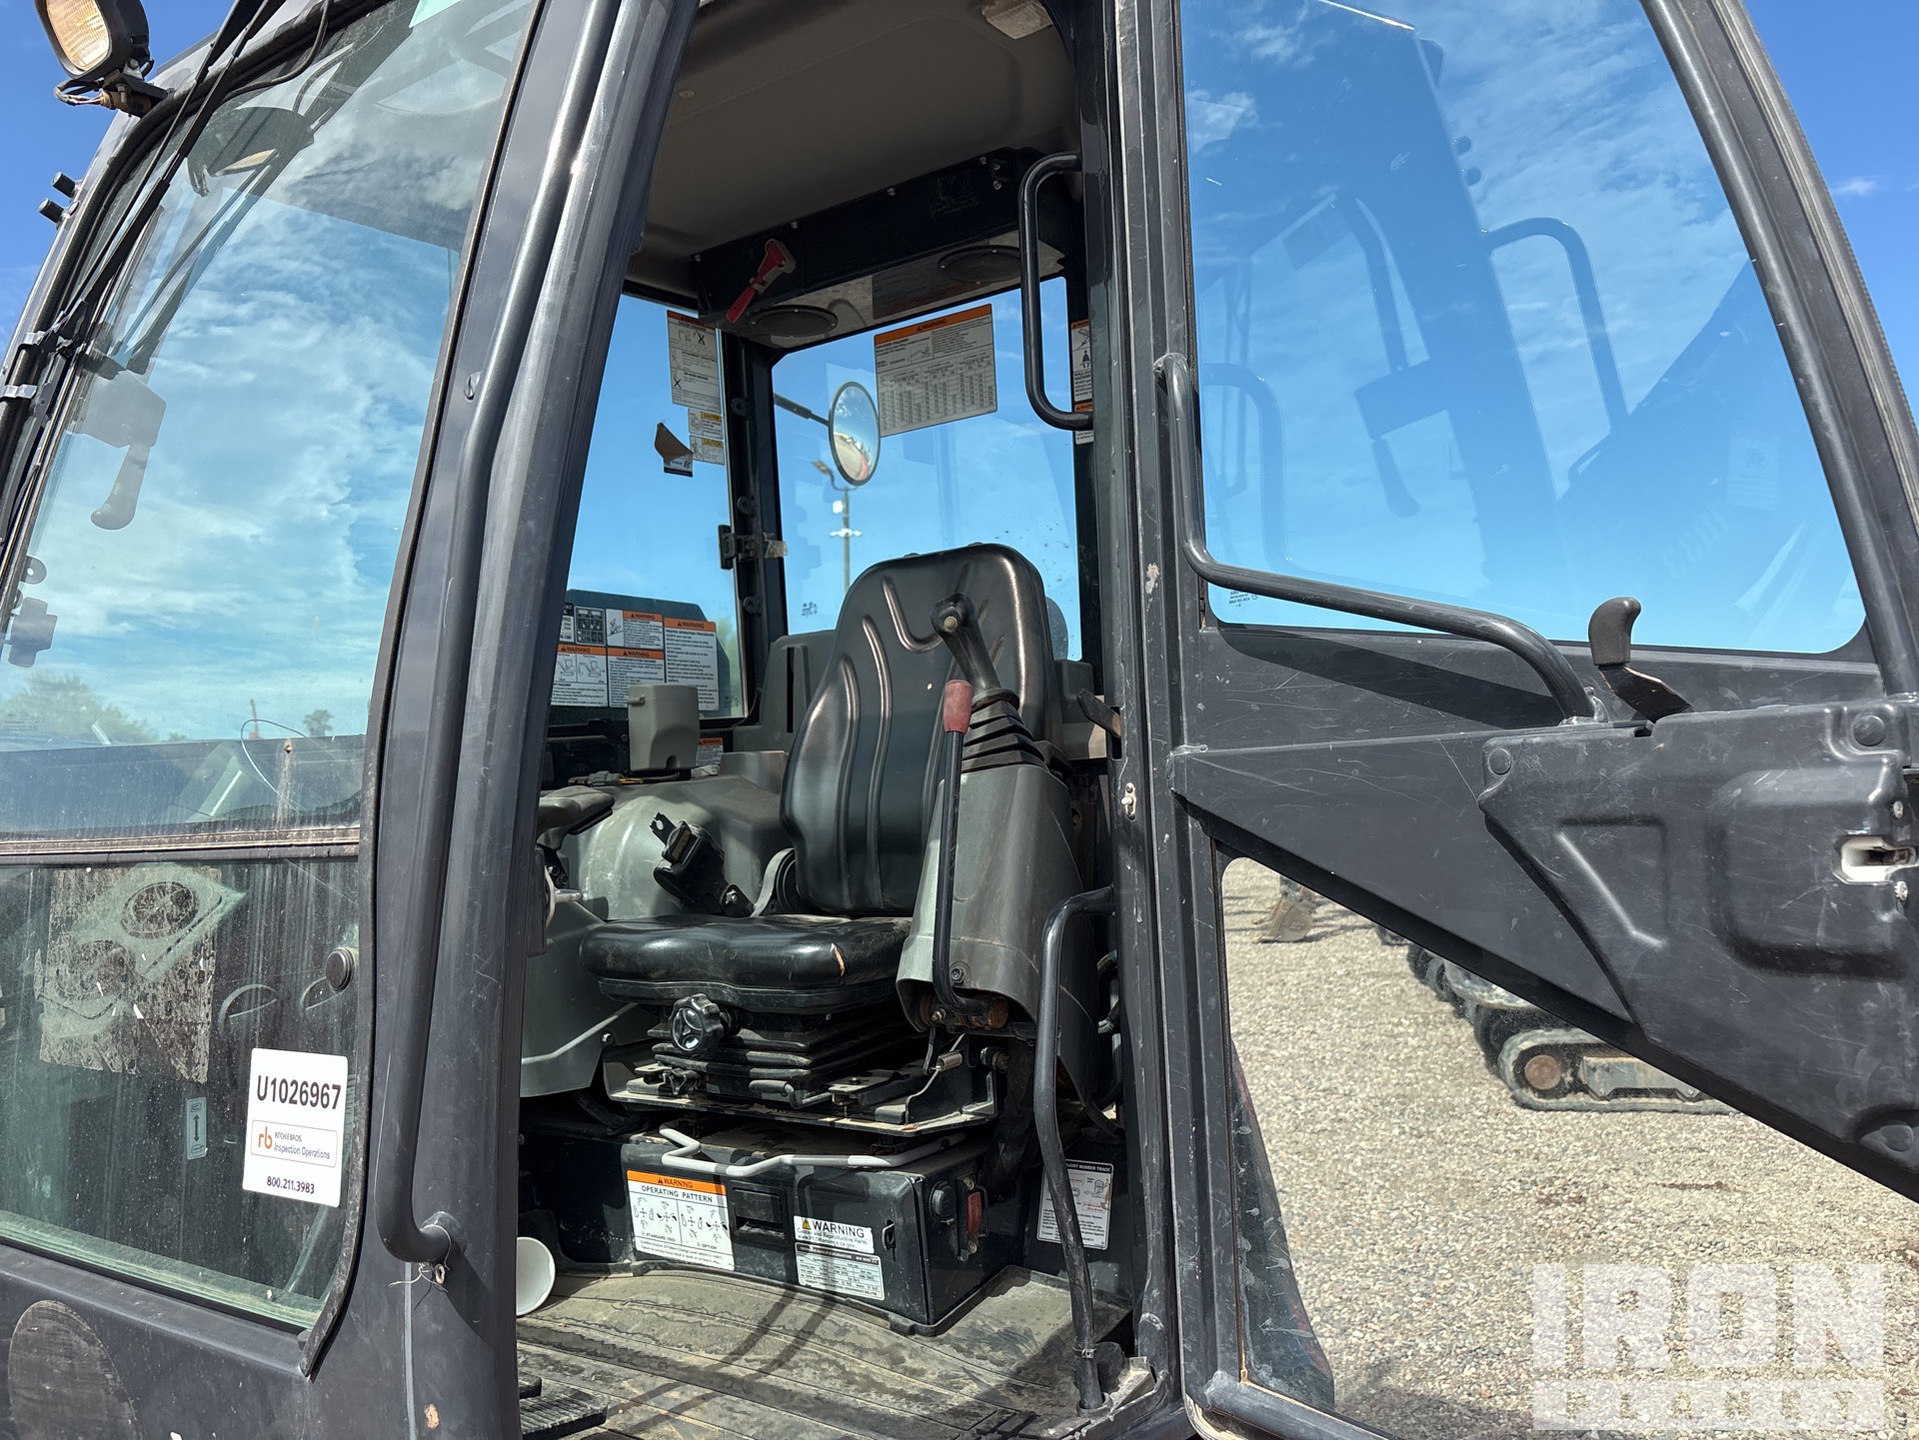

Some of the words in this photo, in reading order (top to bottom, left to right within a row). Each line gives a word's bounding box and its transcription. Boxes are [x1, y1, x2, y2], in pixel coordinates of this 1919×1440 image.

[257, 1075, 341, 1110] U1026967
[258, 1126, 273, 1149] rb
[274, 1142, 301, 1154] Inspection
[301, 1146, 330, 1159] Operations
[267, 1176, 315, 1194] 800.211.3983
[664, 1178, 693, 1189] WARNING
[641, 1185, 679, 1197] OPERATING
[682, 1191, 713, 1203] PATTERN
[812, 1220, 865, 1238] WARNING
